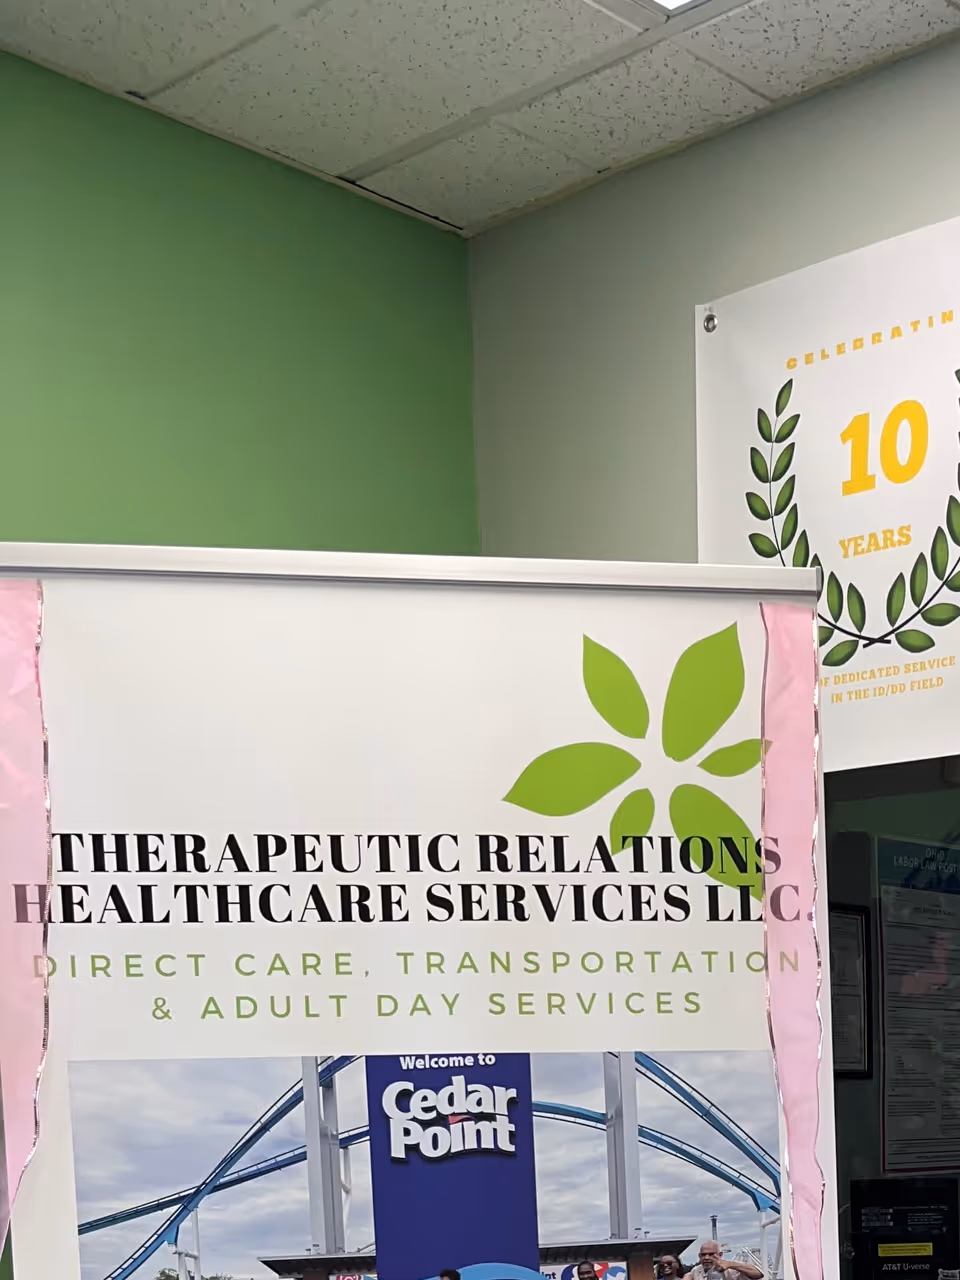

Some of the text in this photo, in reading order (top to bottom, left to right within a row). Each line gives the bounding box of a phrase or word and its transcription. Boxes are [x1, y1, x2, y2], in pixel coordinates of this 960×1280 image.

[840, 400, 929, 496] 10
[839, 525, 912, 558] YEARS
[833, 665, 900, 686] DEDICATED
[904, 656, 956, 675] SERVICE
[831, 676, 944, 704] IN THE ID/DD FIELD
[52, 833, 782, 875] THERAPEUTIC RELATIONS
[12, 883, 409, 924] HEALTHCARE
[426, 883, 692, 923] SERVICES
[33, 949, 799, 979] DIRECT CARE, TRANSPORTATION
[151, 991, 703, 1021] & ADULT DAY SERVICES
[400, 1053, 496, 1070] Welcome to
[382, 1075, 517, 1120] Cedar
[390, 1115, 515, 1158] Point
[882, 1262, 901, 1271] AT&T
